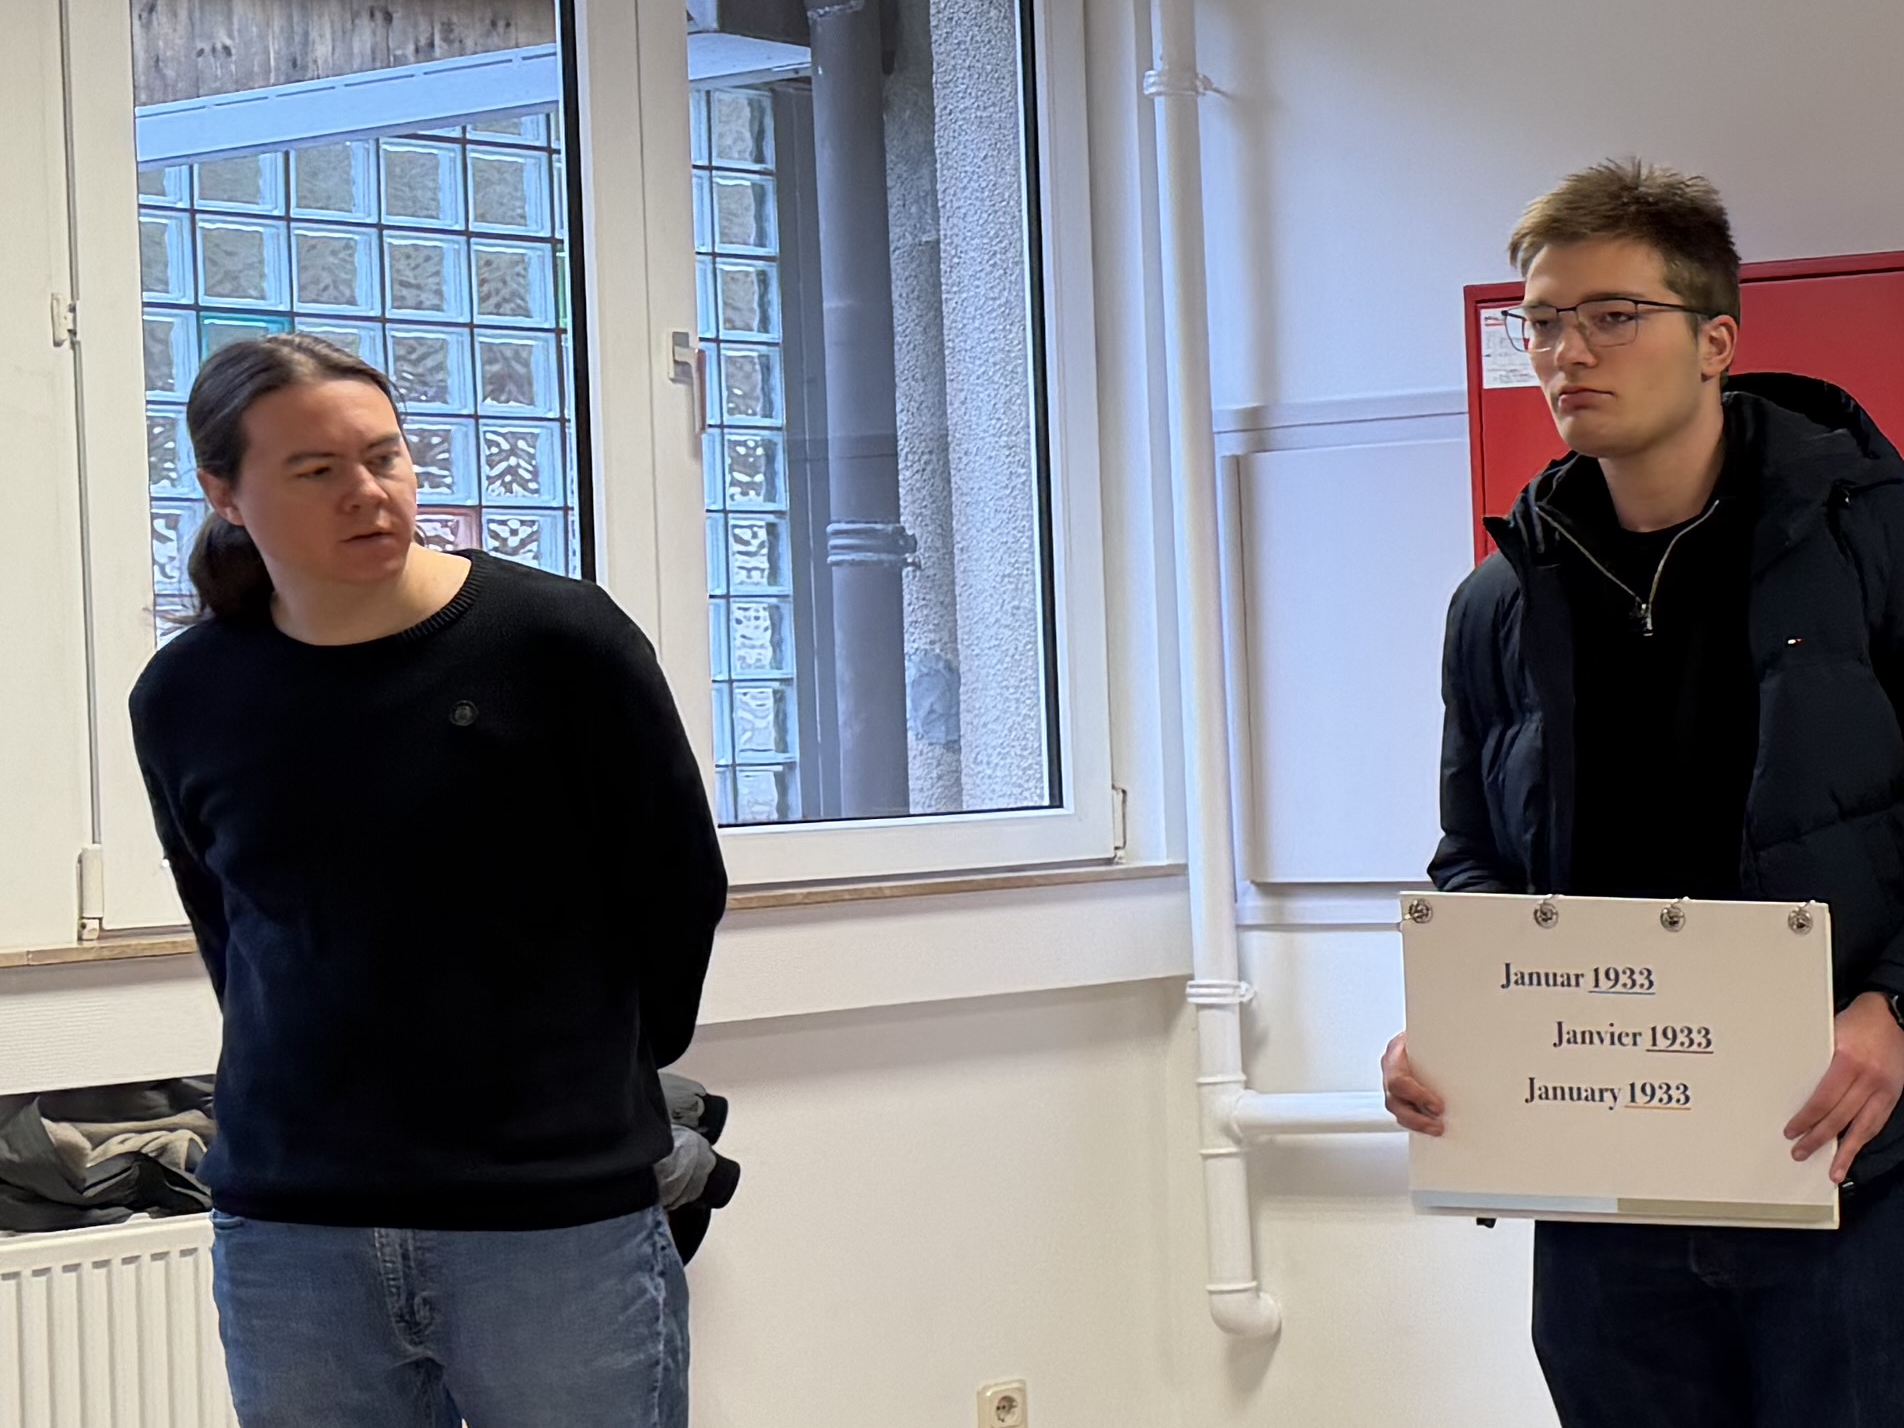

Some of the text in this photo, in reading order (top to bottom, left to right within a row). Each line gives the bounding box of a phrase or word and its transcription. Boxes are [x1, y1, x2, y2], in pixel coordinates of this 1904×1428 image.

[1501, 963, 1654, 989] Januar 1933
[1554, 1022, 1712, 1049] Janvier 1933
[1525, 1078, 1690, 1109] January 1933
